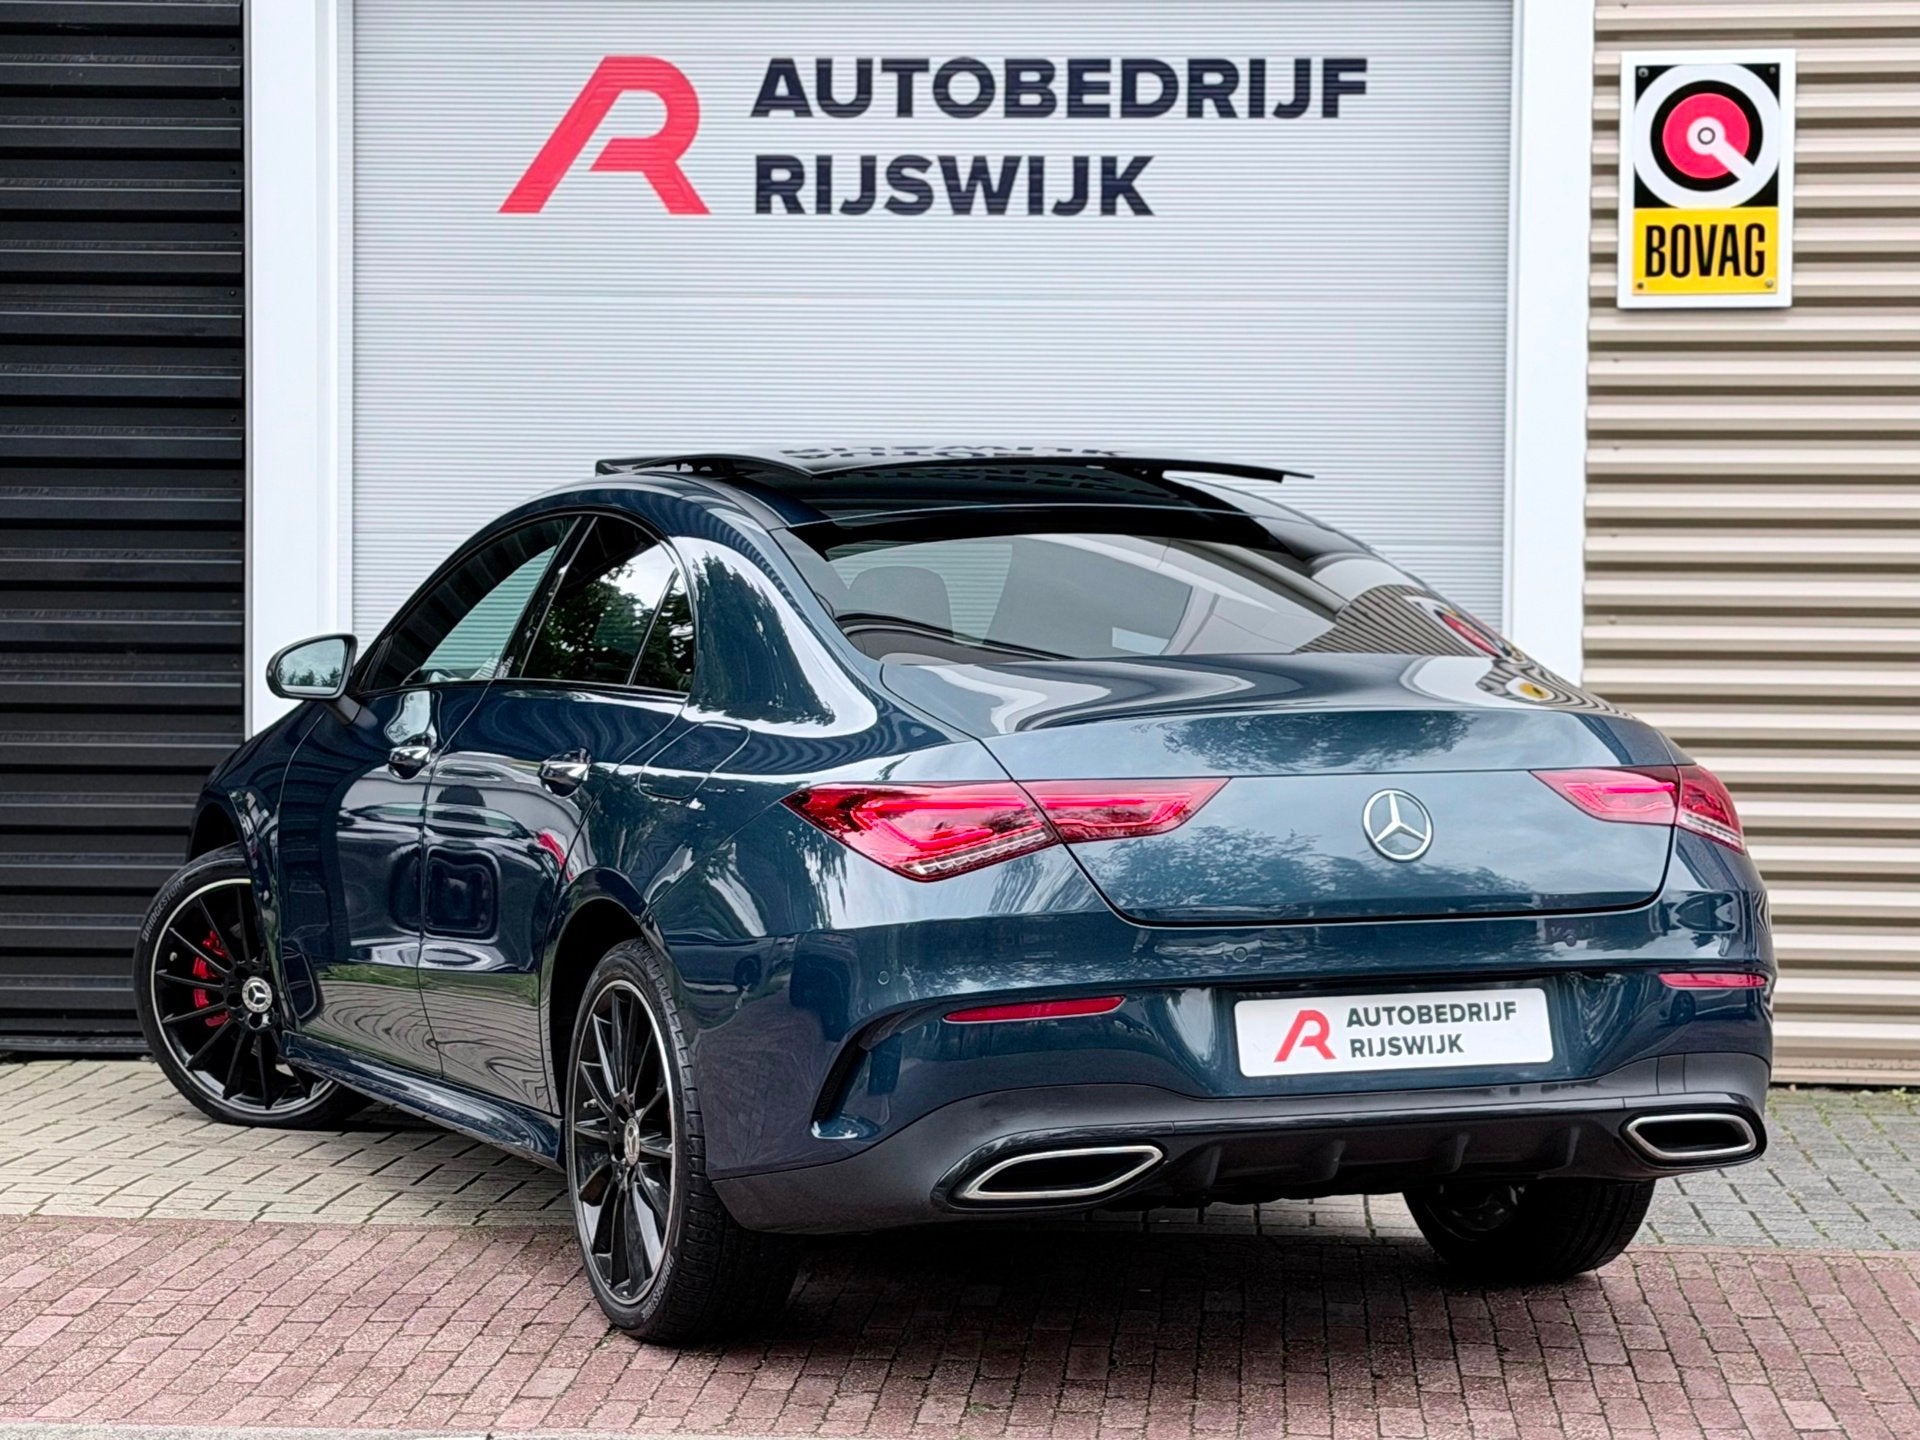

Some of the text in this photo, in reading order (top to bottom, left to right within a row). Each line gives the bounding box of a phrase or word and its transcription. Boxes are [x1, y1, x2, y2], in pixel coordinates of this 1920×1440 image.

[750, 57, 1368, 119] AUTOBEDRIJF
[755, 154, 1153, 217] RIJSWIJK
[1645, 223, 1765, 278] BOVAG
[1346, 1001, 1517, 1028] AUTOBEDRIJF
[1350, 1034, 1464, 1058] RIJSWIJK
